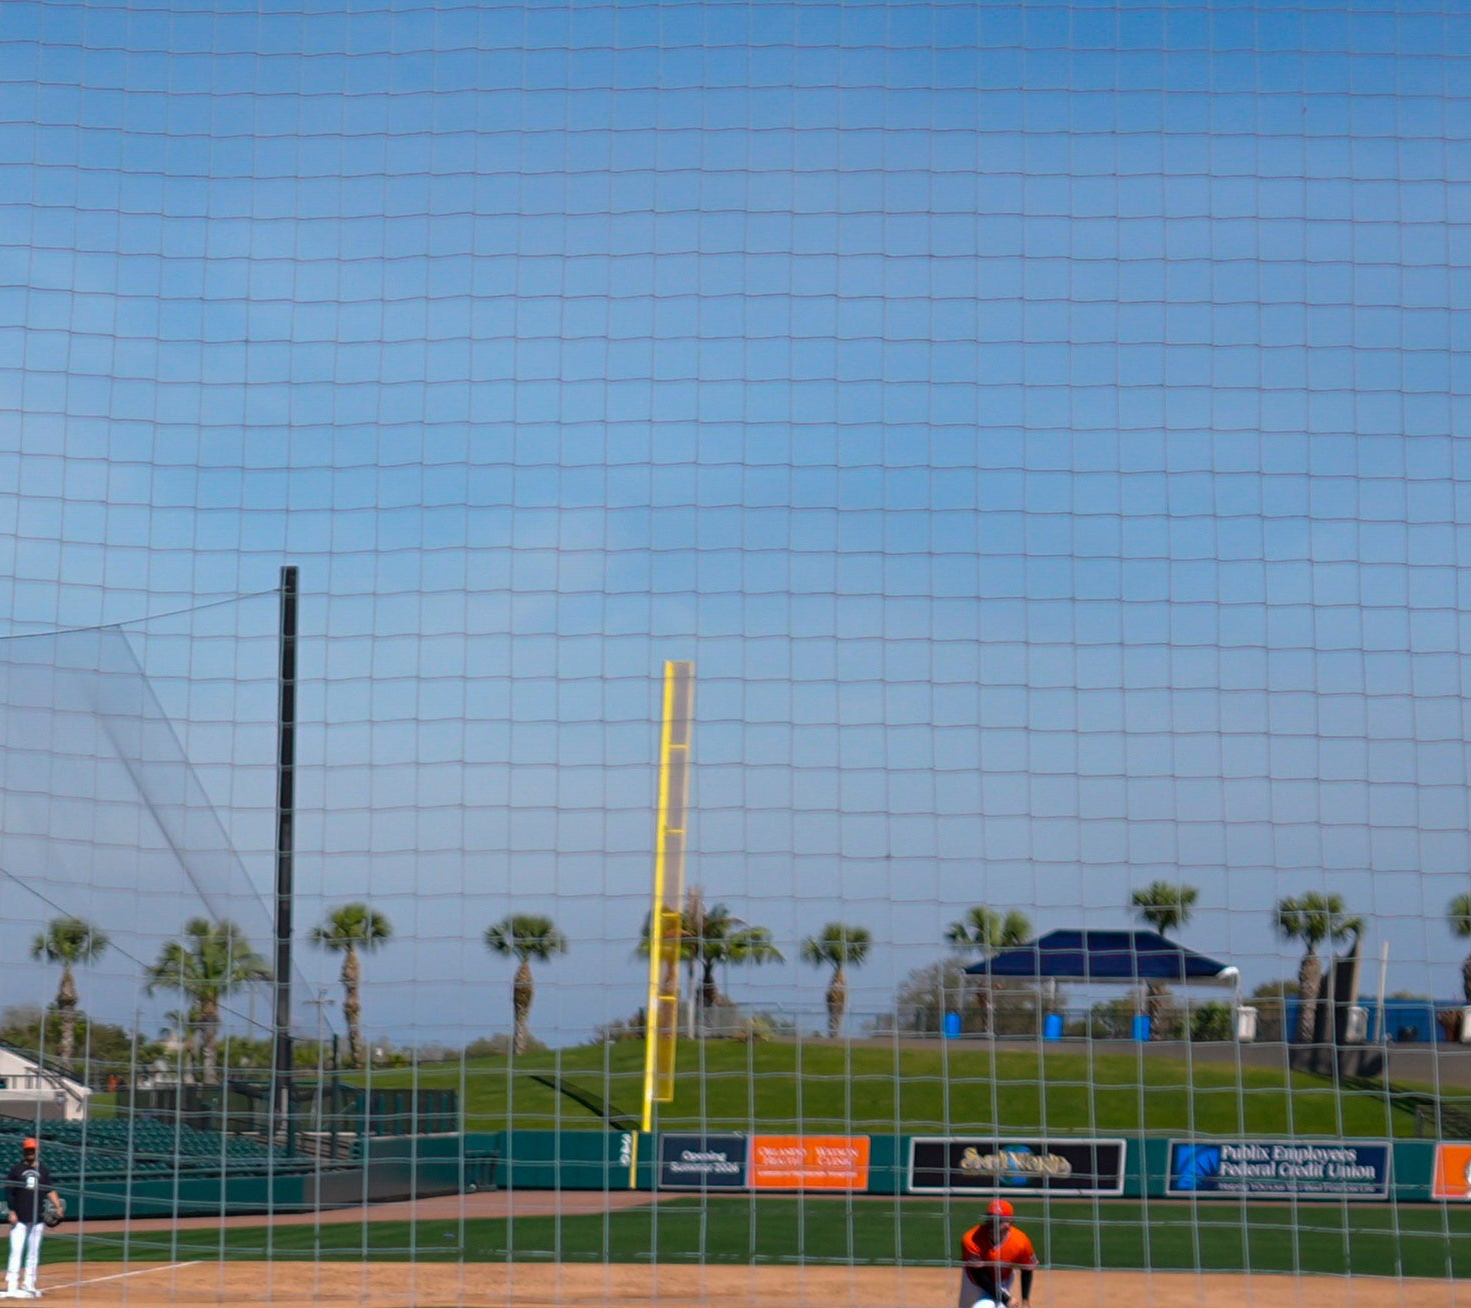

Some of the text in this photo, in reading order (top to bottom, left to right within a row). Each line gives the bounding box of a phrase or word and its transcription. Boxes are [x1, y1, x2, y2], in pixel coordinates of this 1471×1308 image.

[1221, 1145, 1357, 1164] Publix Employees
[1219, 1161, 1376, 1179] Federal Credit Union
